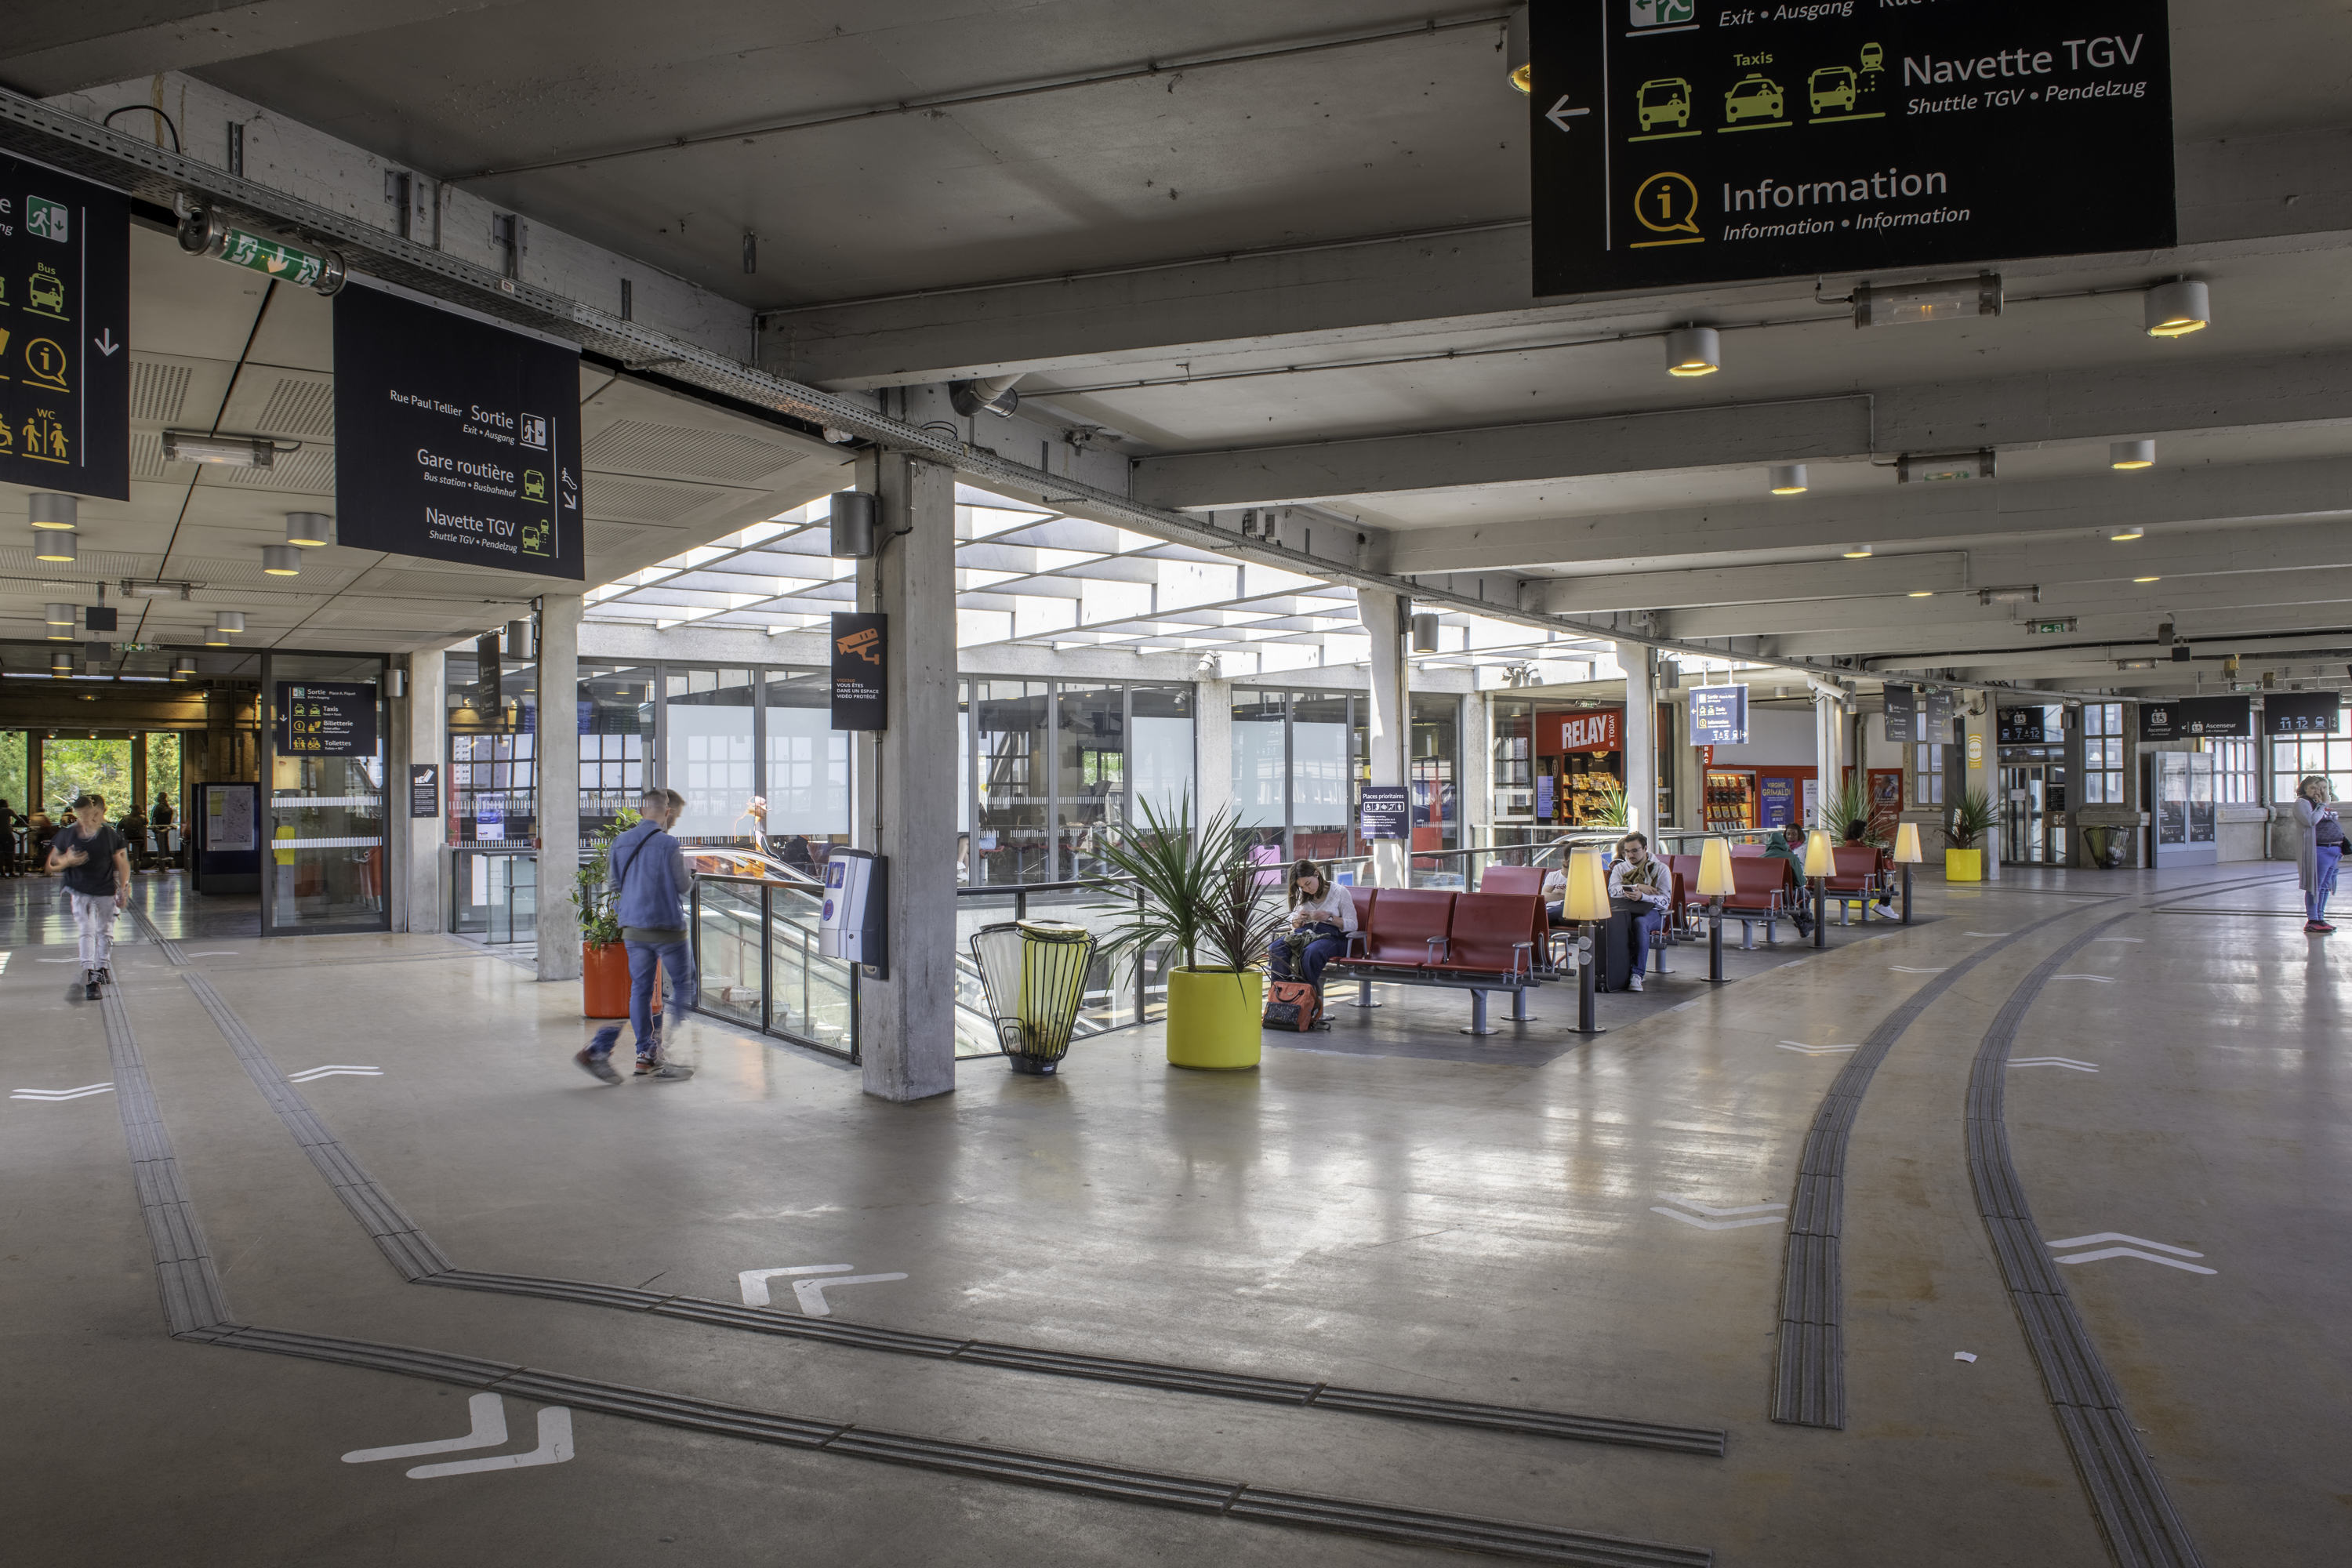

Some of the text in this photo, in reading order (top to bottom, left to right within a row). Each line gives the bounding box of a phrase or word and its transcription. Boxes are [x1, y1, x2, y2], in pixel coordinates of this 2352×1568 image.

[1719, 1, 1854, 27] Exit Ausgang
[1733, 52, 1773, 67] Taxis
[1904, 33, 2143, 87] Navette TGV
[1906, 81, 2147, 115] Shuttle TGV Pendelzug
[1723, 167, 1947, 212] Information
[1723, 206, 1970, 241] Information Information
[38, 263, 56, 274] Bus
[37, 408, 56, 420] WC
[390, 390, 514, 429] Rue Paul Tellier Sortie
[463, 424, 515, 445] Exit Ausgang
[417, 448, 514, 483] Gare routière
[424, 472, 517, 498] Bus station Busbahnhof
[426, 507, 515, 536] Navette TGV
[429, 530, 517, 554] Shuttle TGV Pendelzug
[1563, 714, 1607, 750] RELAY
[2296, 720, 2308, 728] 12
[1762, 788, 1791, 797] GRIMALDI
